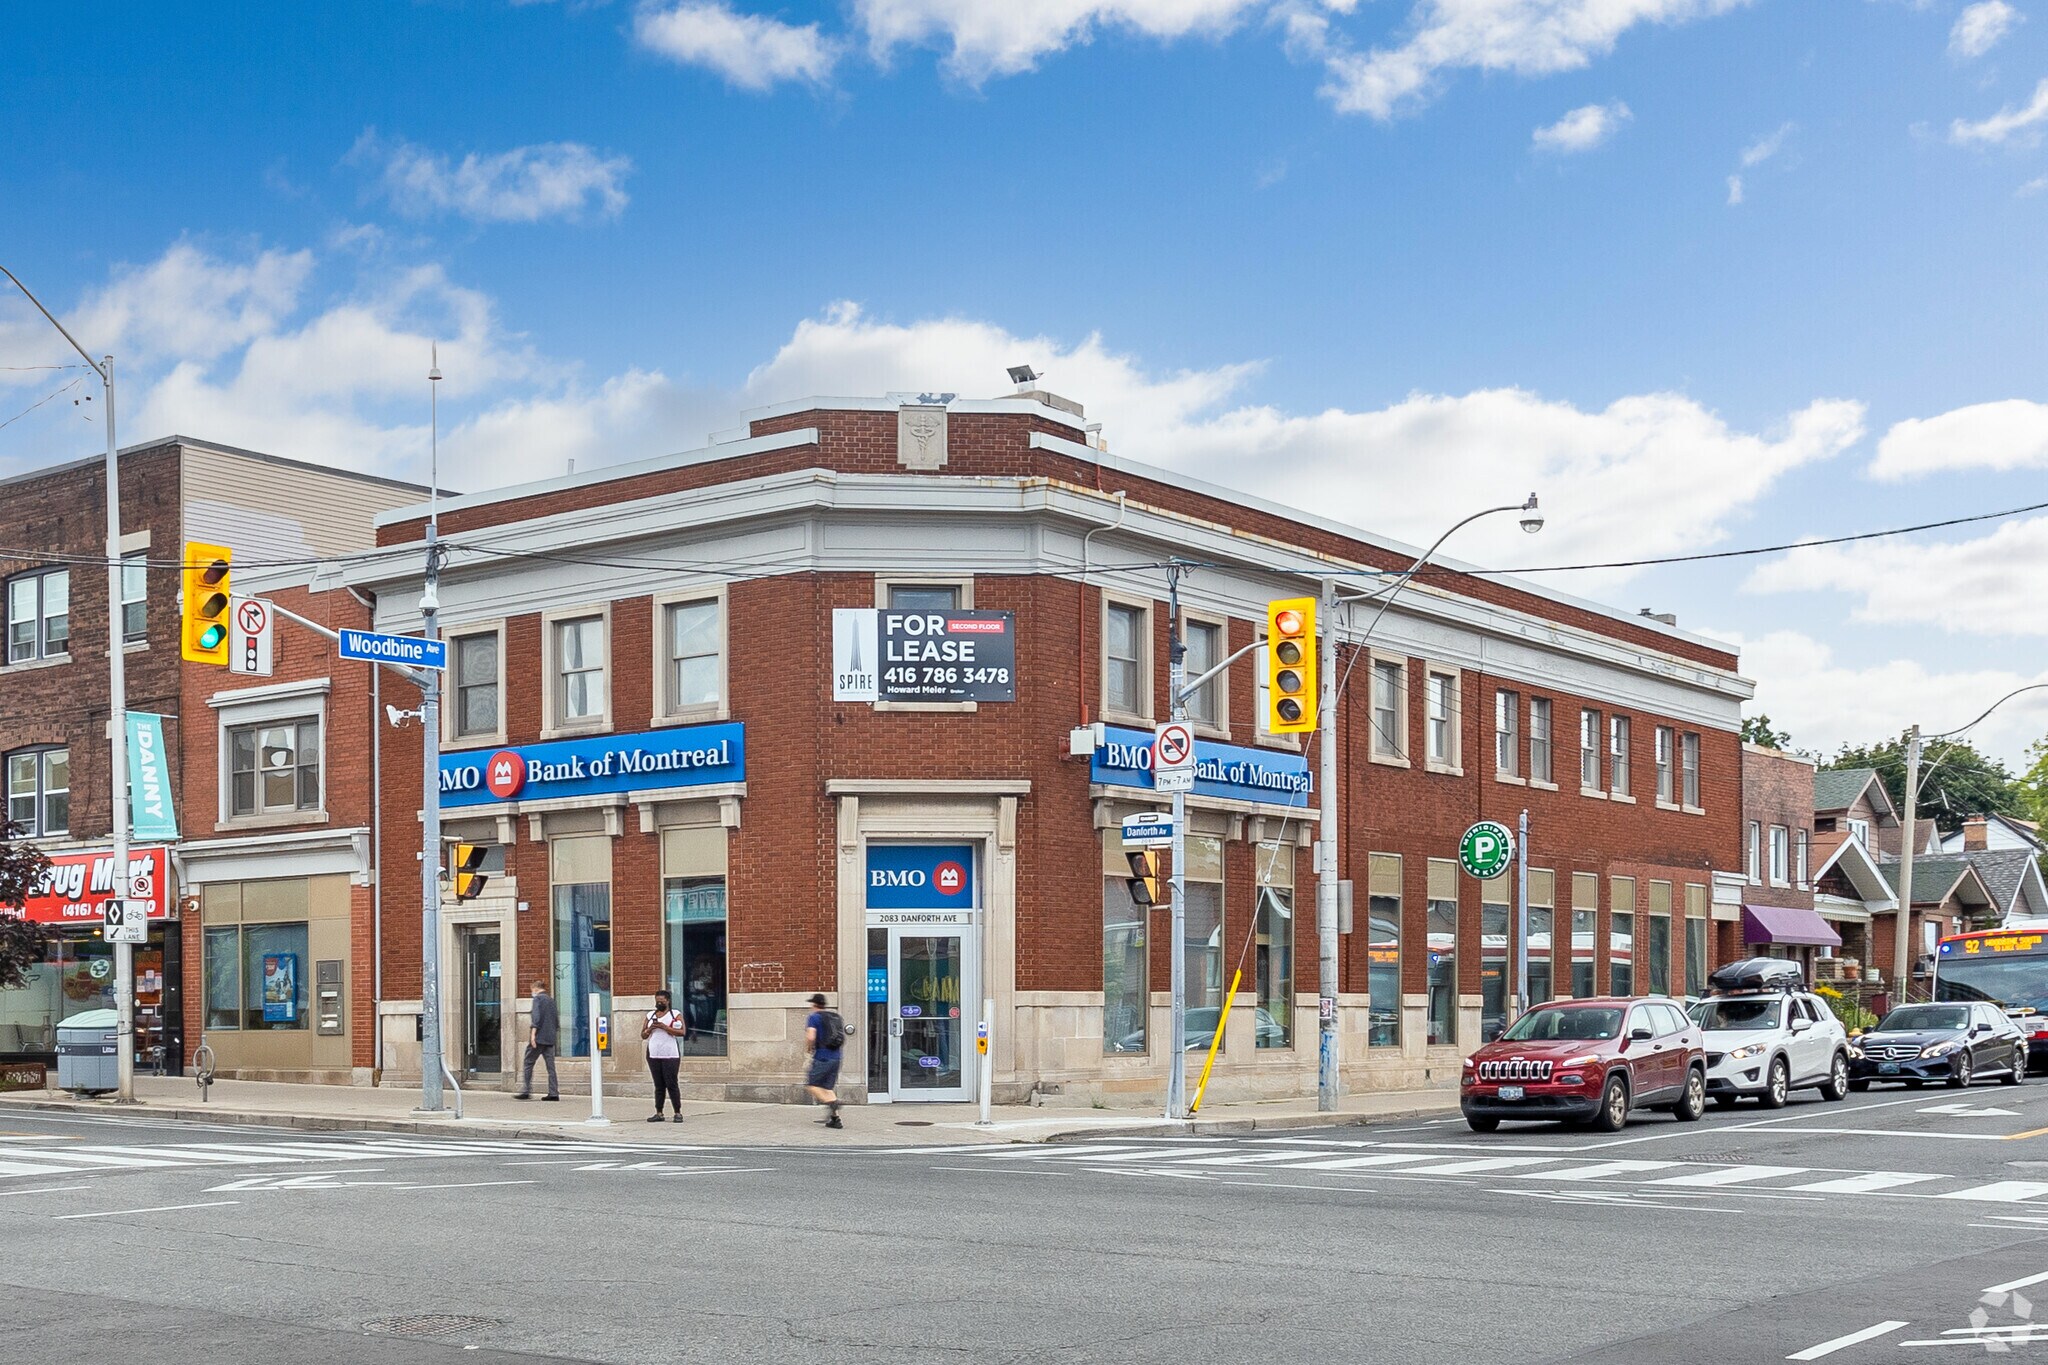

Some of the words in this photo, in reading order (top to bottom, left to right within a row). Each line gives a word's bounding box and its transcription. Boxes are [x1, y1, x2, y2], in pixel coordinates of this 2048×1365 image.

[886, 614, 945, 636] FOR
[951, 623, 978, 631] SECOND
[979, 623, 1000, 631] FLOOR
[348, 633, 423, 660] Woodbine
[425, 643, 440, 654] Ave
[886, 640, 976, 662] LEASE
[839, 674, 873, 690] SPIRE
[884, 667, 917, 684] 416
[922, 667, 958, 684] 786
[963, 667, 1009, 684] 3478
[886, 685, 921, 695] Howard
[526, 755, 584, 784] Bank
[590, 751, 613, 777] of
[618, 739, 731, 775] Montreal
[1107, 742, 1151, 771] BMO
[137, 730, 164, 819] DANNY
[438, 766, 480, 792] MO
[1230, 762, 1247, 784] of
[1249, 763, 1314, 793] Montreal
[1126, 826, 1158, 837] Danforth
[1463, 825, 1506, 846] MUNICIPAL
[1475, 836, 1495, 859] P
[90, 855, 155, 892] Mrt
[1462, 853, 1507, 876] PARKING
[870, 869, 926, 888] BMO
[62, 902, 91, 917] (416)
[879, 914, 899, 923] 2083
[900, 914, 941, 923] DANFORTH
[942, 914, 957, 923] AVE
[1964, 939, 1980, 954] 92
